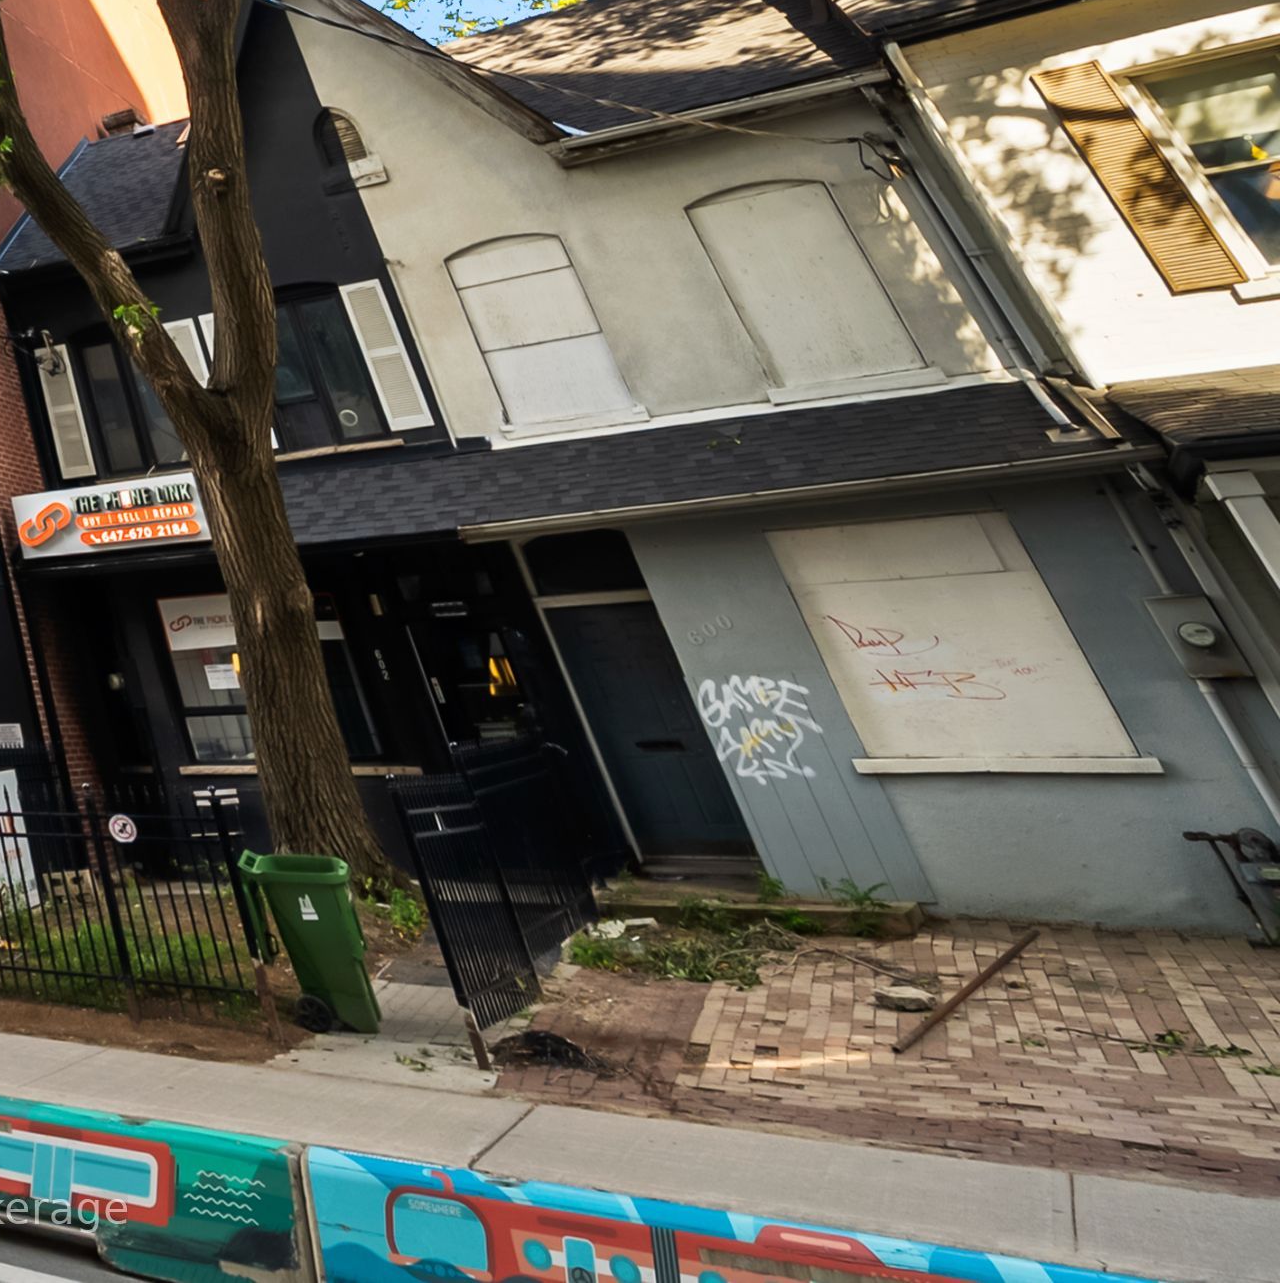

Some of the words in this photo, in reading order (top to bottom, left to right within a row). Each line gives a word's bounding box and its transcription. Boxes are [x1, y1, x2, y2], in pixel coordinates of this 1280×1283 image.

[72, 495, 101, 514] THE
[155, 482, 193, 504] LINK
[82, 516, 101, 528] BUY
[117, 512, 141, 524] SELL
[152, 505, 190, 519] REPAIR
[101, 526, 153, 543] 647-670
[156, 522, 189, 537] 2184
[687, 613, 734, 646] 600
[374, 648, 391, 681] 602
[407, 1198, 462, 1217] SOMEWHERE
